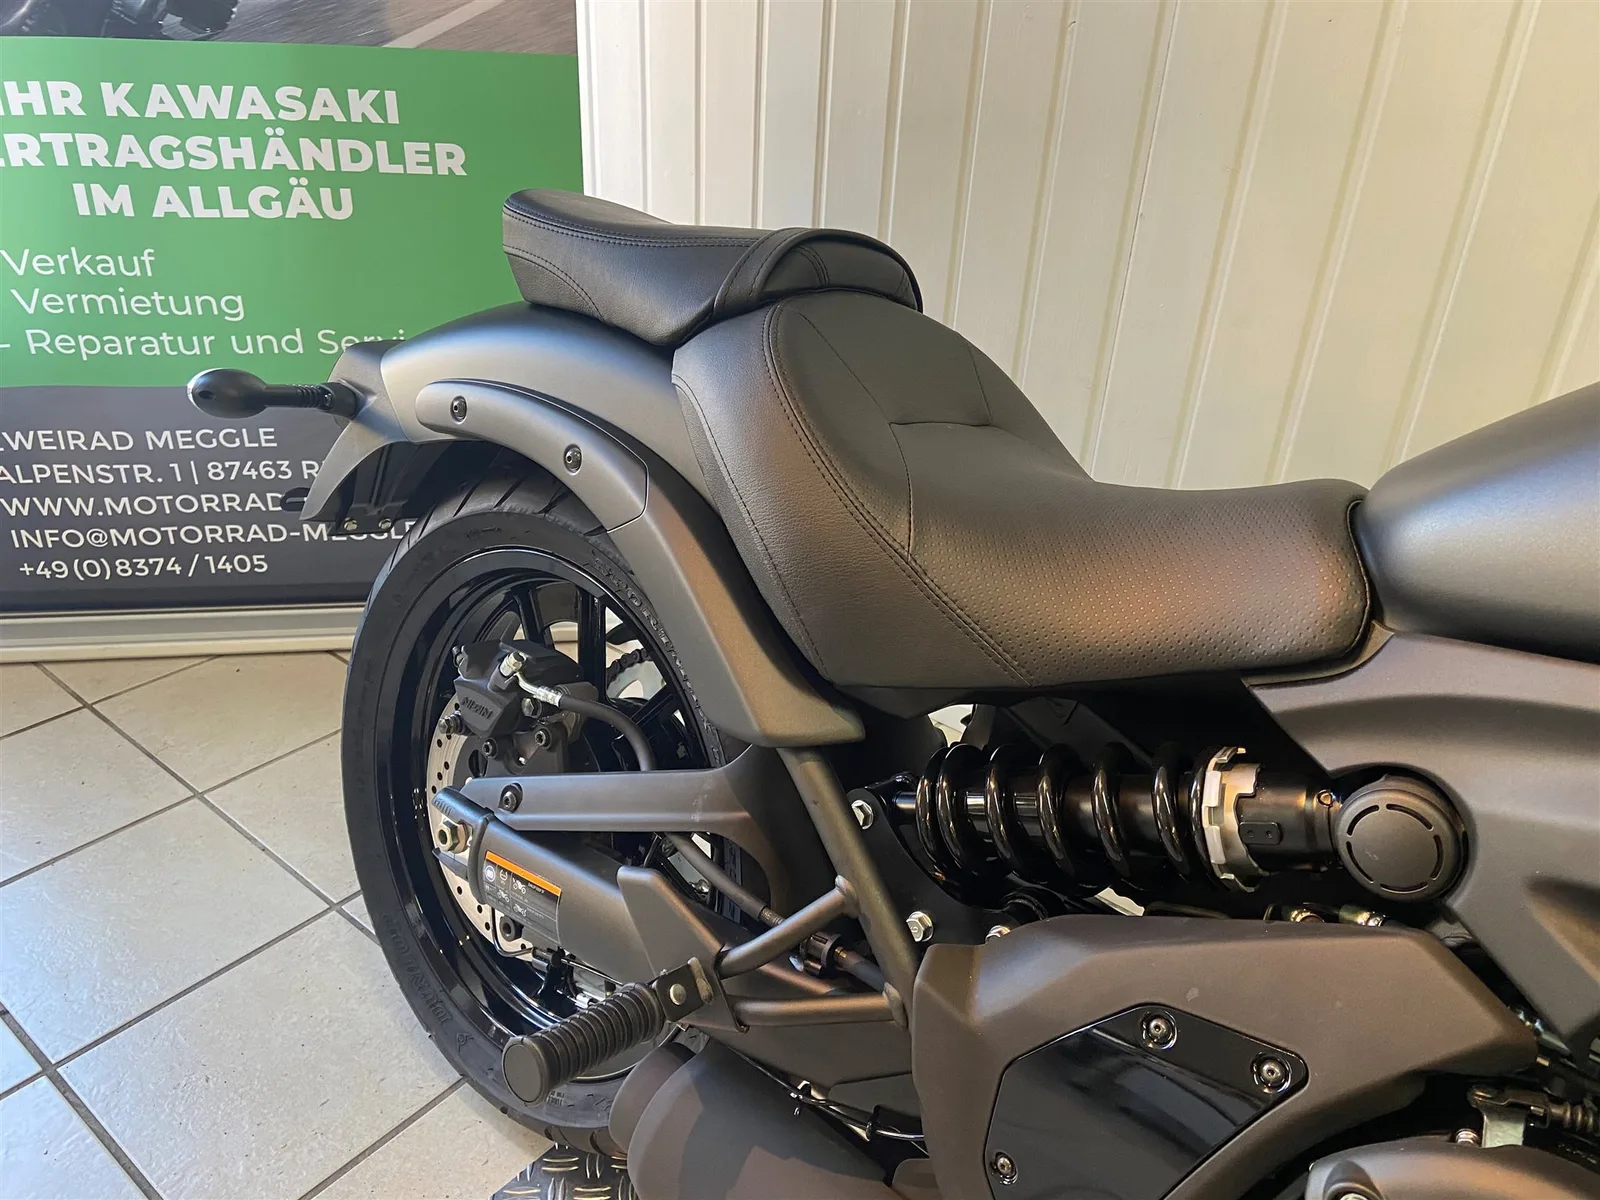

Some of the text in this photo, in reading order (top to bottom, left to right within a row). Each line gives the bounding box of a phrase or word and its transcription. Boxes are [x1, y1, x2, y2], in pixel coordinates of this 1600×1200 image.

[0, 80, 400, 125] HR KAWASAKI
[0, 126, 468, 176] RTRAGSHÄNDLER
[72, 176, 354, 220] IM ALLGÄU
[0, 246, 155, 277] Verkauf
[9, 287, 245, 322] Vermietung
[25, 329, 215, 361] Reparatur
[230, 327, 304, 355] und
[0, 427, 278, 452] WEIRAD MEGGLE
[0, 463, 163, 485] ALPENSTR.
[169, 463, 182, 482] 1
[207, 460, 293, 481] 87463
[204, 554, 269, 575] 1405
